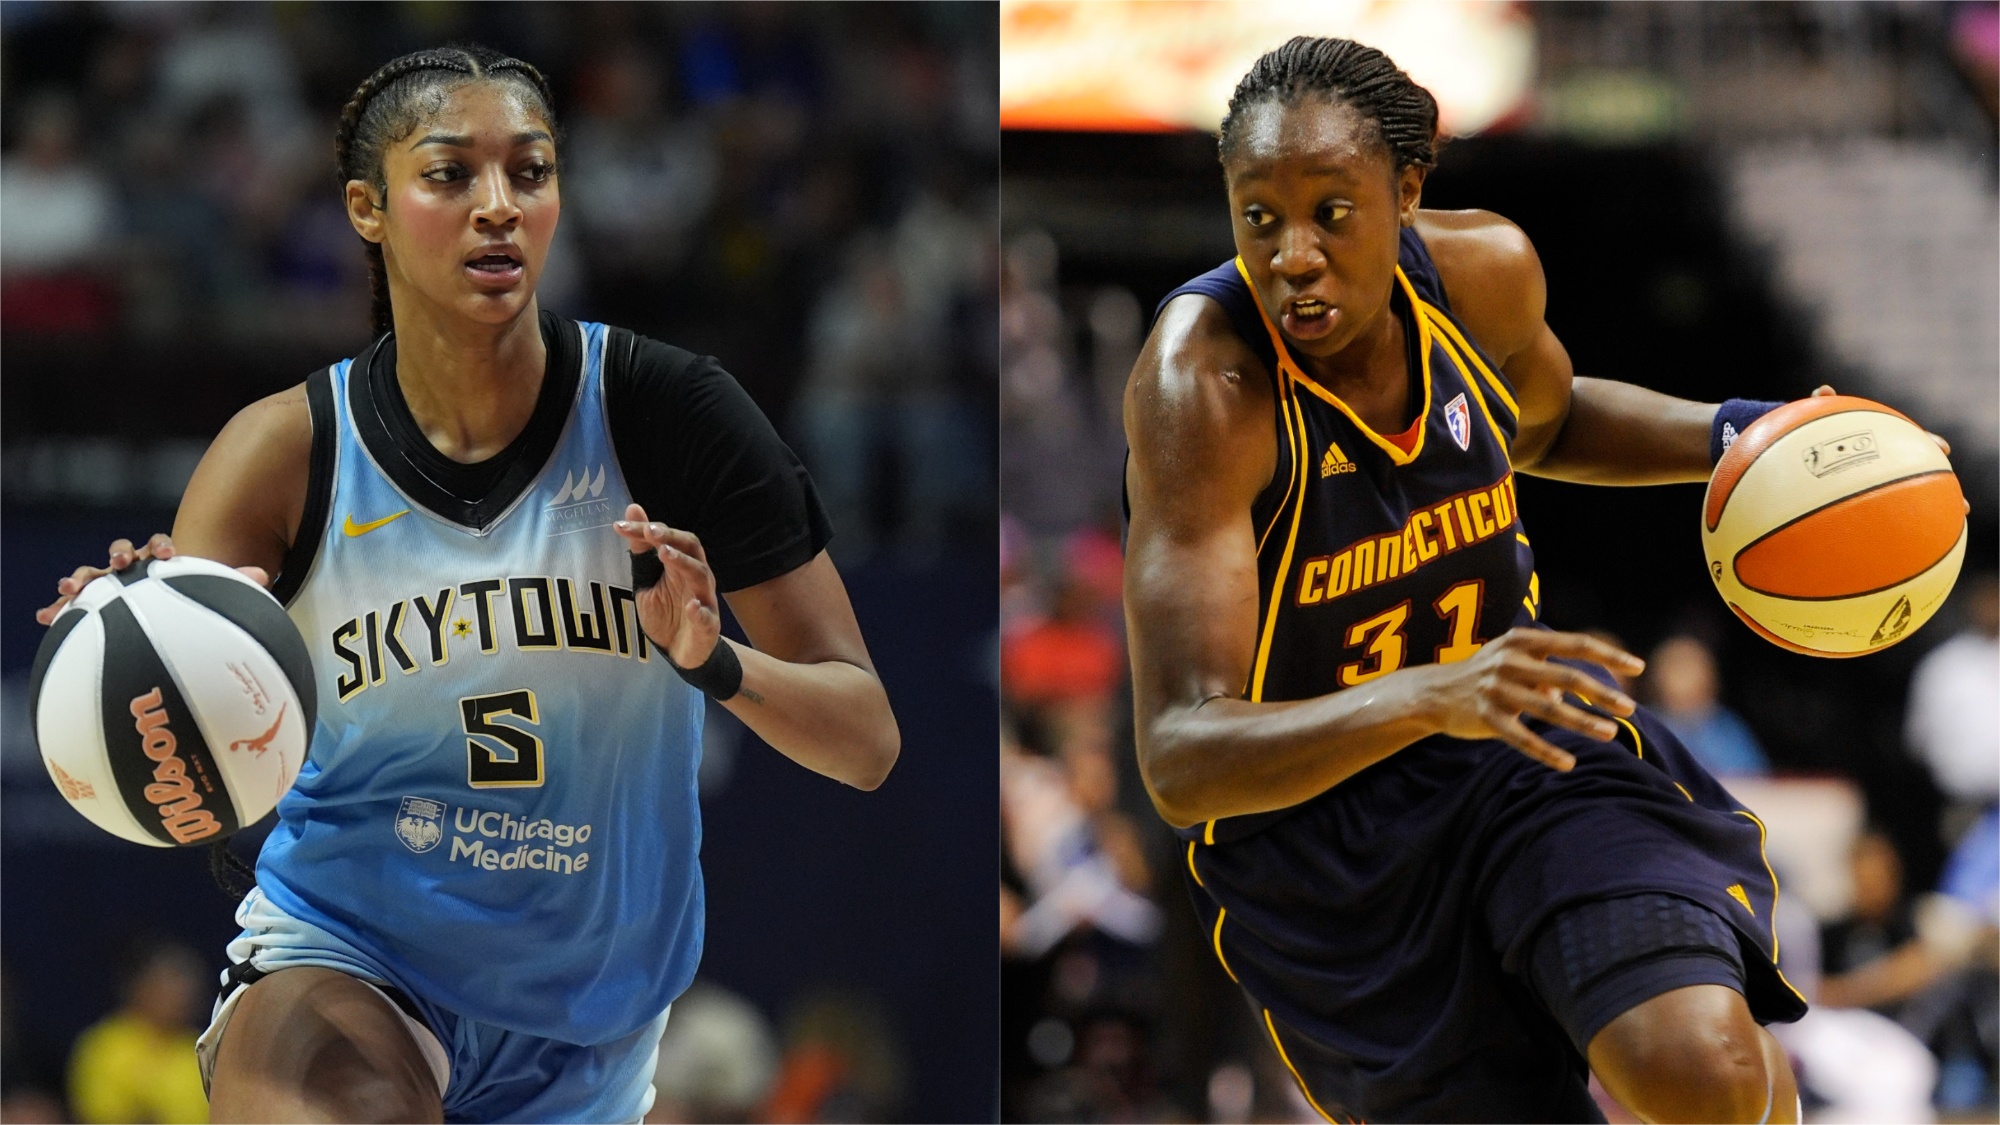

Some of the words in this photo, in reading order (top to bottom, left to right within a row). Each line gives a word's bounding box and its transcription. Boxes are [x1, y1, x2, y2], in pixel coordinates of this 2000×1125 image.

[1722, 422, 1732, 452] adid
[544, 501, 610, 523] MAGELLAN
[1296, 472, 1516, 607] CONNECTICUT
[1338, 579, 1486, 688] 31
[130, 686, 222, 844] Wilson
[458, 688, 545, 790] 5
[449, 836, 590, 875] Medicine
[454, 807, 592, 845] UChicago
